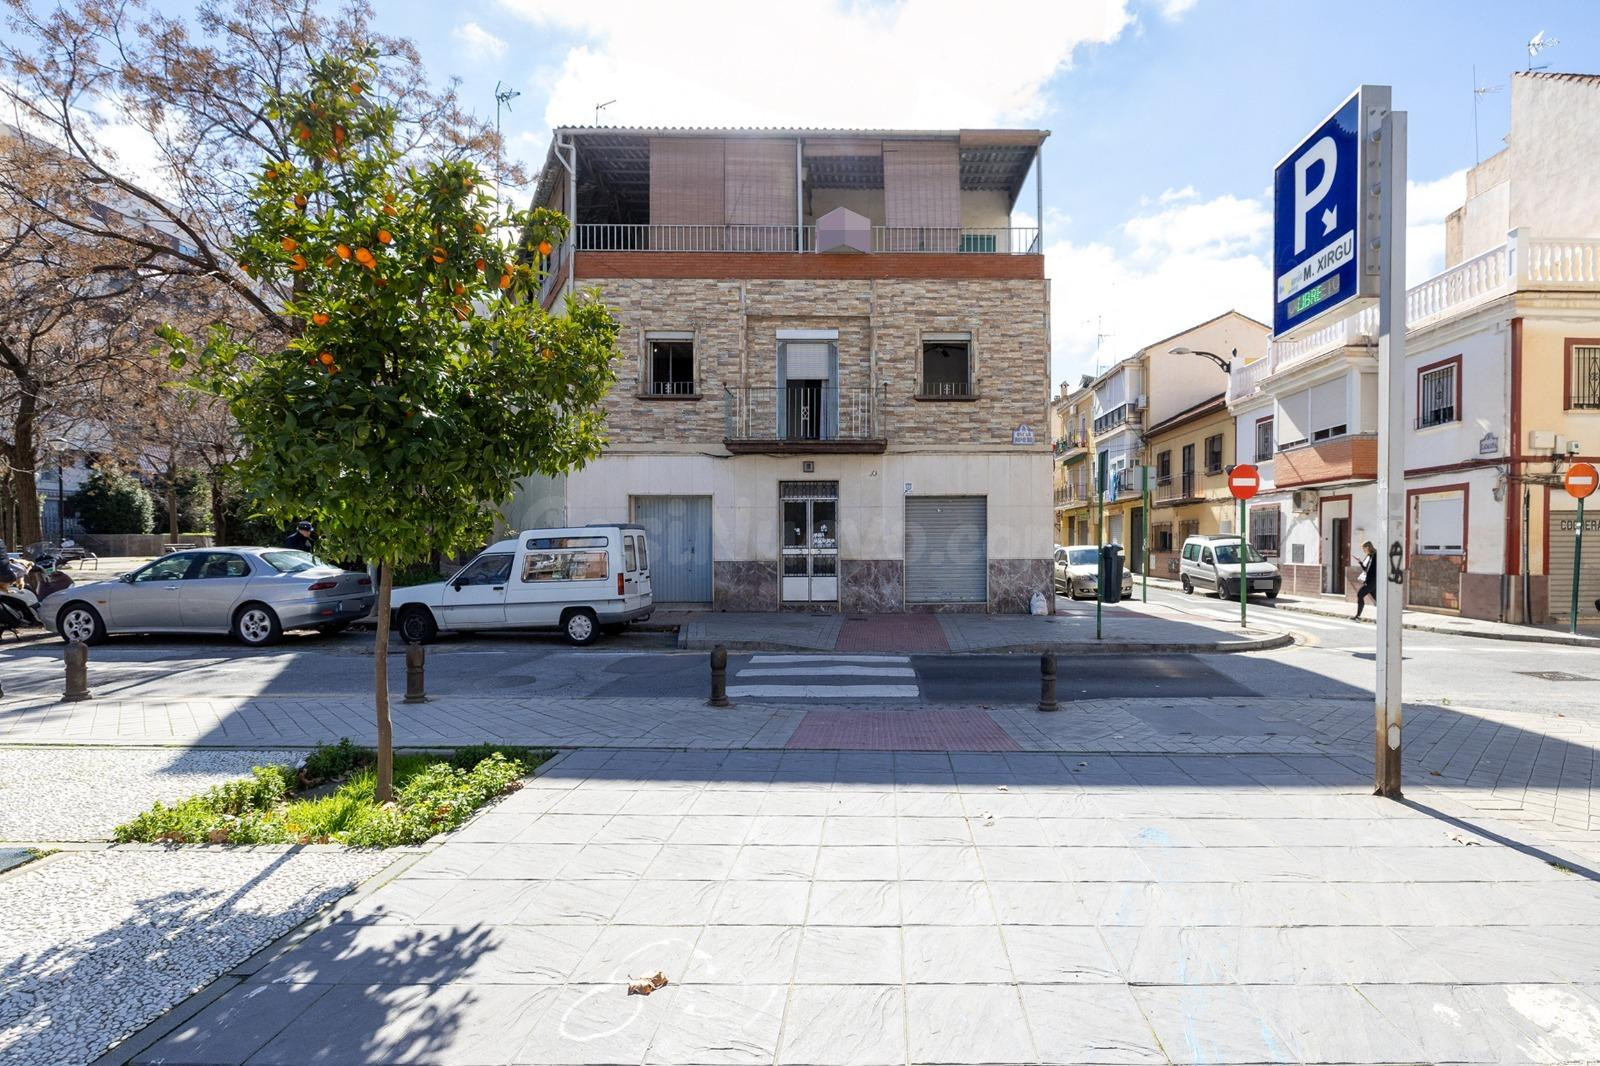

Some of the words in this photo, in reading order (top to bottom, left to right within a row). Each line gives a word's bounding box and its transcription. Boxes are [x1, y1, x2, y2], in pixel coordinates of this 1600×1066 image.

[1294, 136, 1338, 256] P
[1303, 264, 1315, 281] M.
[1317, 238, 1352, 274] XIRGU
[1296, 285, 1322, 312] LIBRE
